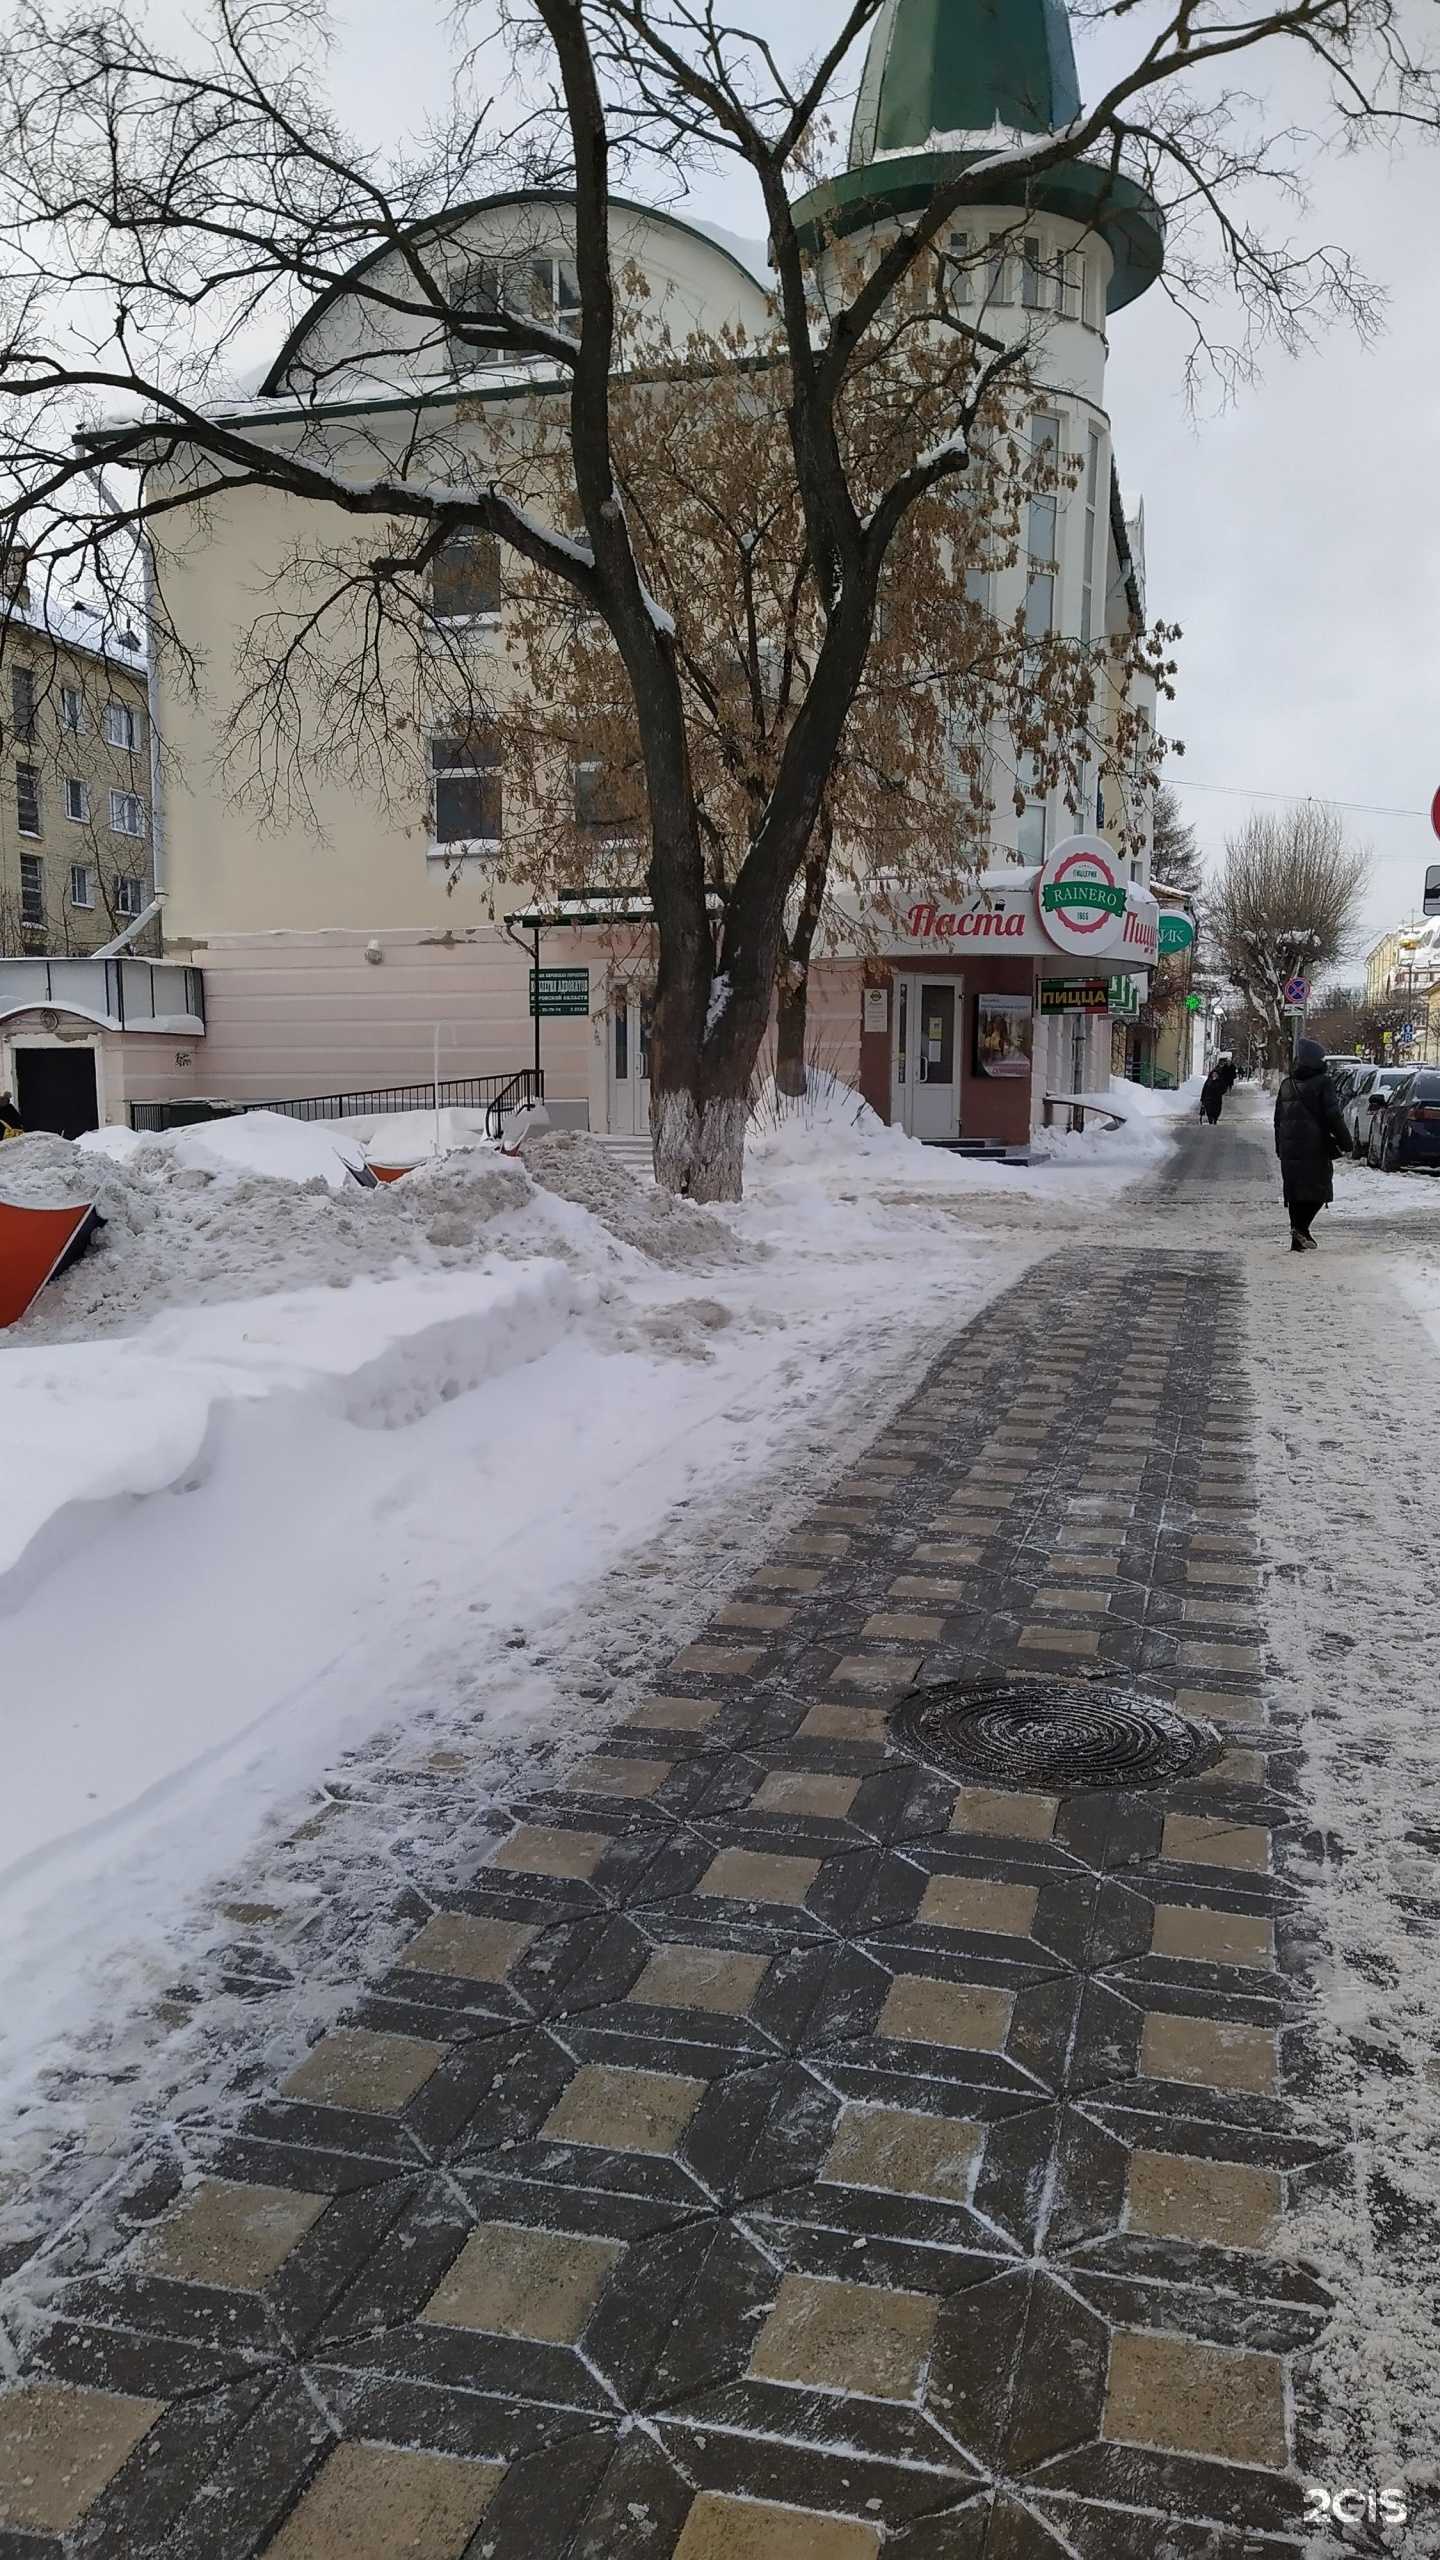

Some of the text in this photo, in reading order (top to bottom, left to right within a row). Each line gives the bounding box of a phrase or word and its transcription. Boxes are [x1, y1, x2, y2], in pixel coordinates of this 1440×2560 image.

[1054, 886, 1117, 906] RAINERO
[907, 903, 1026, 937] Паста
[1042, 990, 1106, 1005] ПИЦЦА
